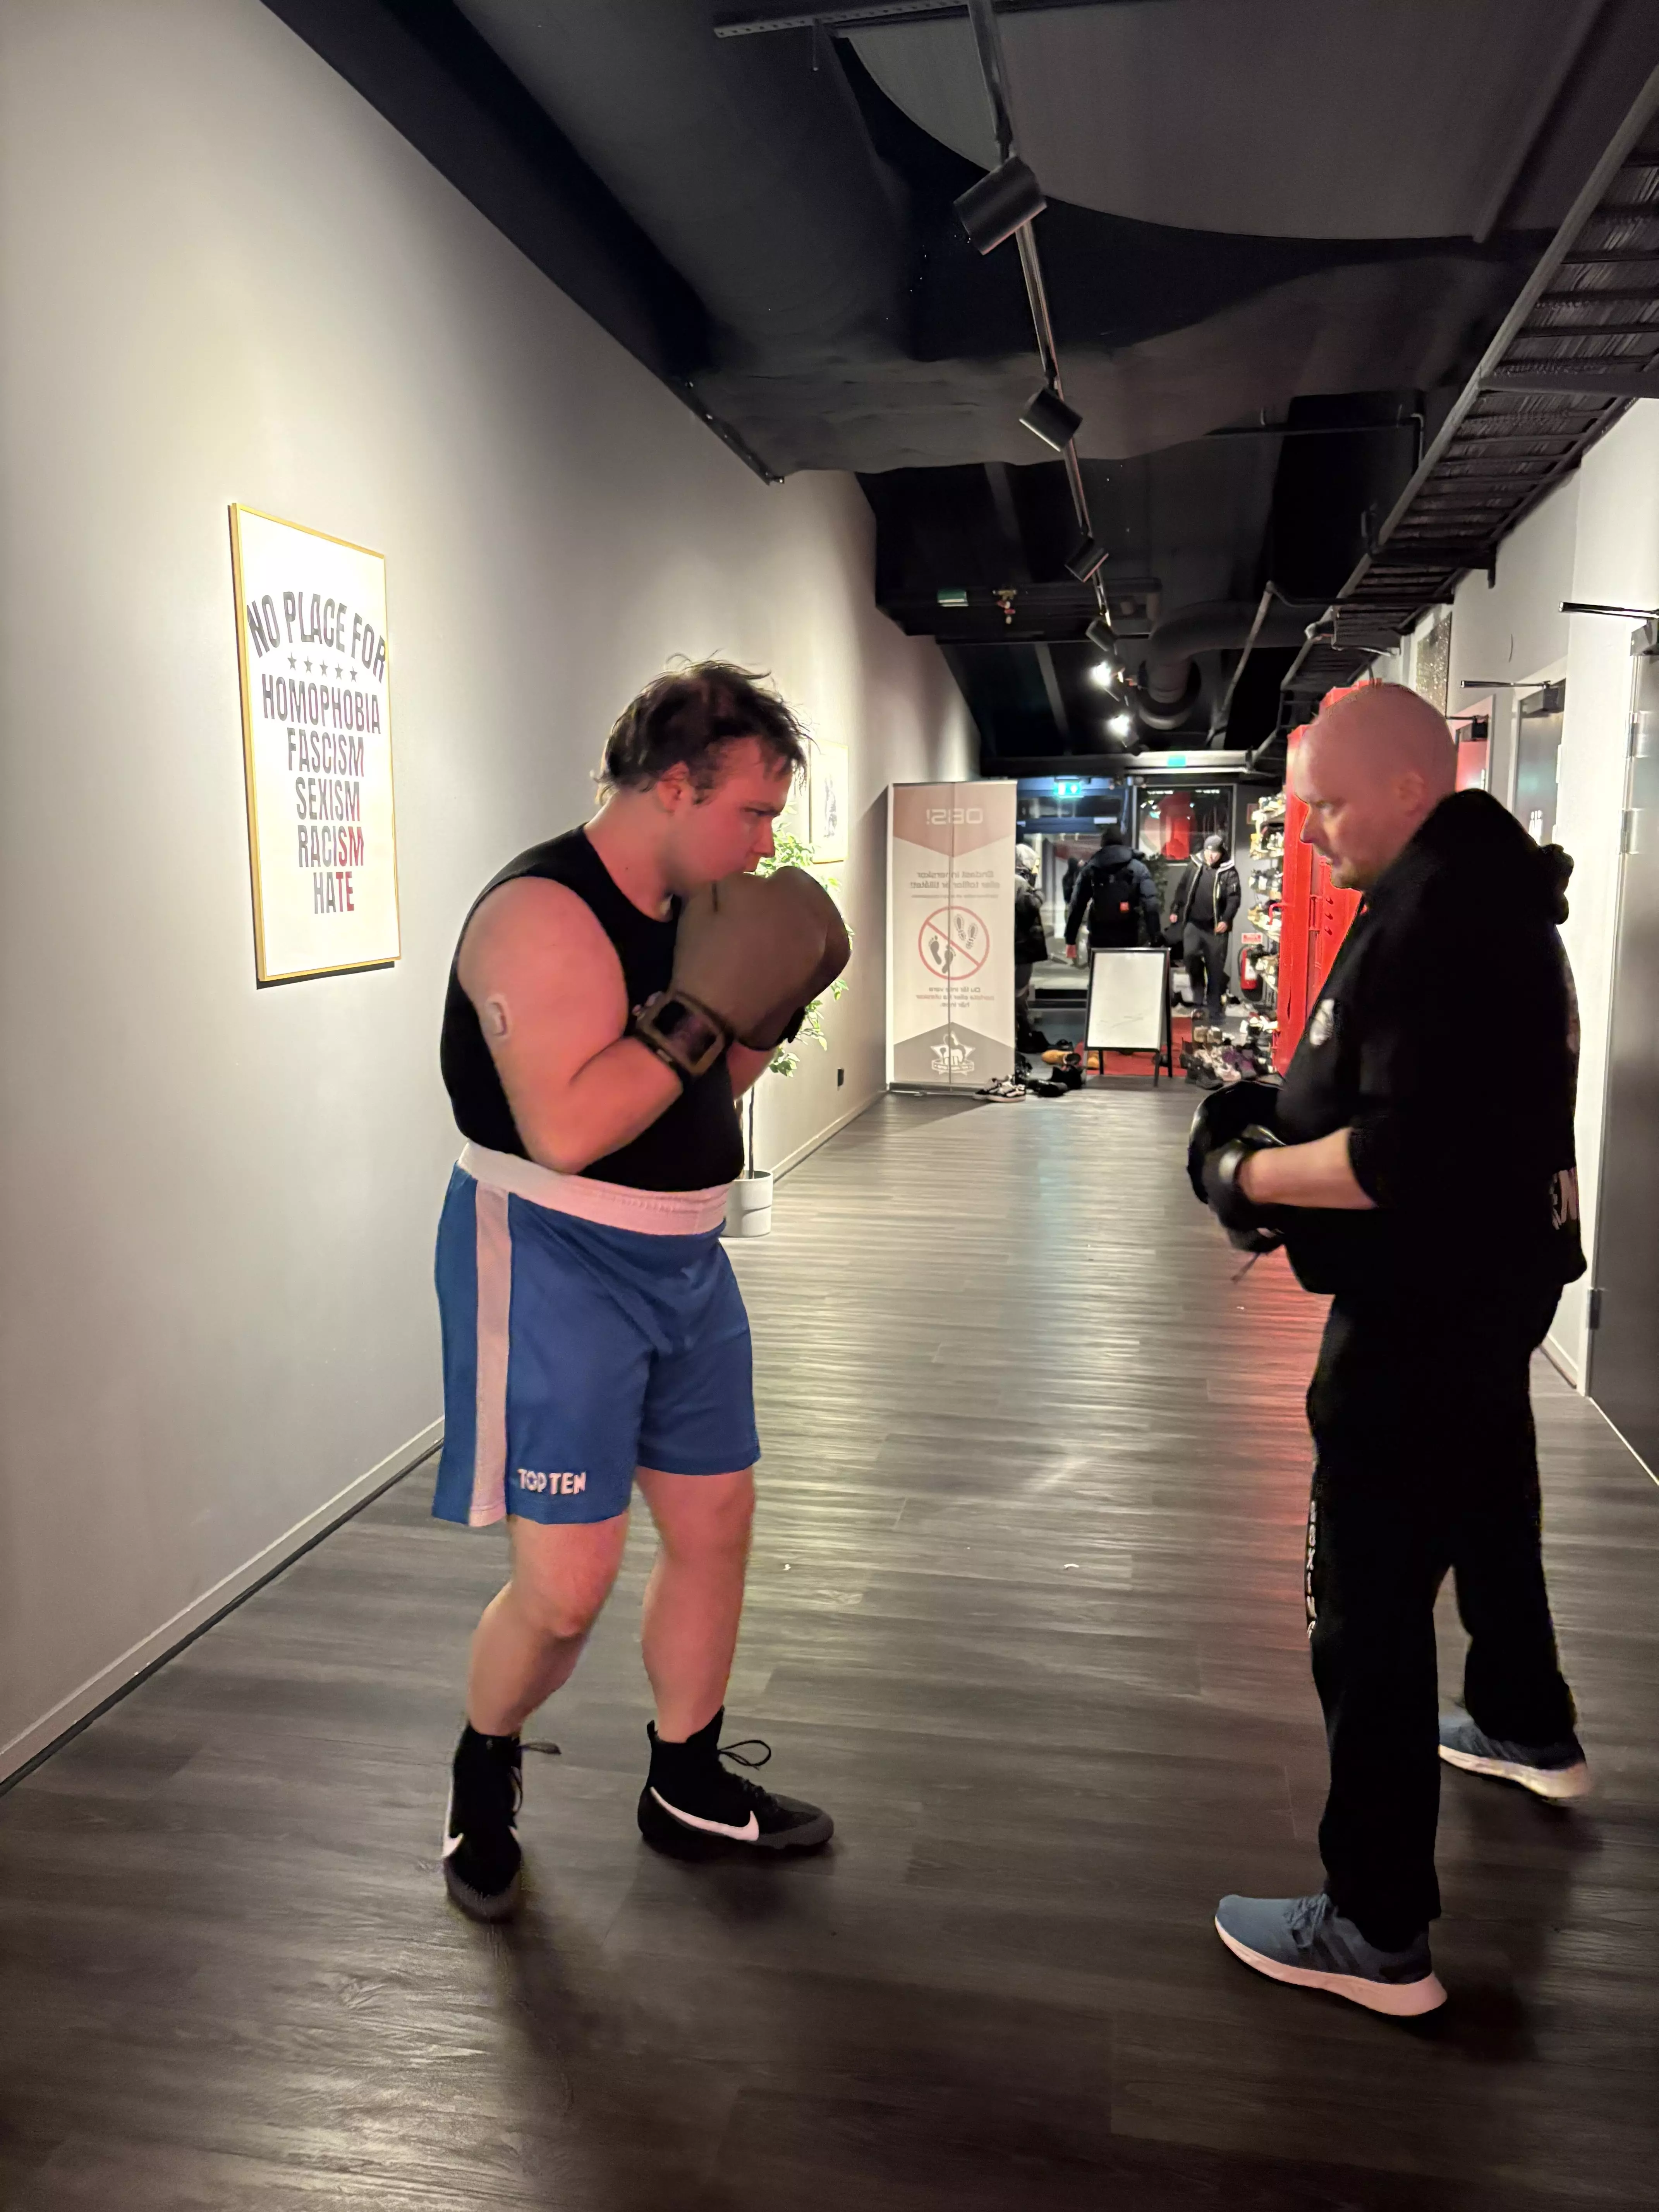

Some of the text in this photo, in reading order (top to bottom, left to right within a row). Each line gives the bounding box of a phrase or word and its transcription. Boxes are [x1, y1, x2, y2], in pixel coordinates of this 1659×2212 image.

[247, 591, 385, 684] NO PLACE FOR
[262, 673, 381, 734] HOMOPHOBIA
[287, 727, 364, 777] FASCISM
[295, 777, 360, 821] SEXISM
[297, 825, 364, 867] RACISM
[313, 871, 354, 914] HATE
[549, 1471, 587, 1495] TEN
